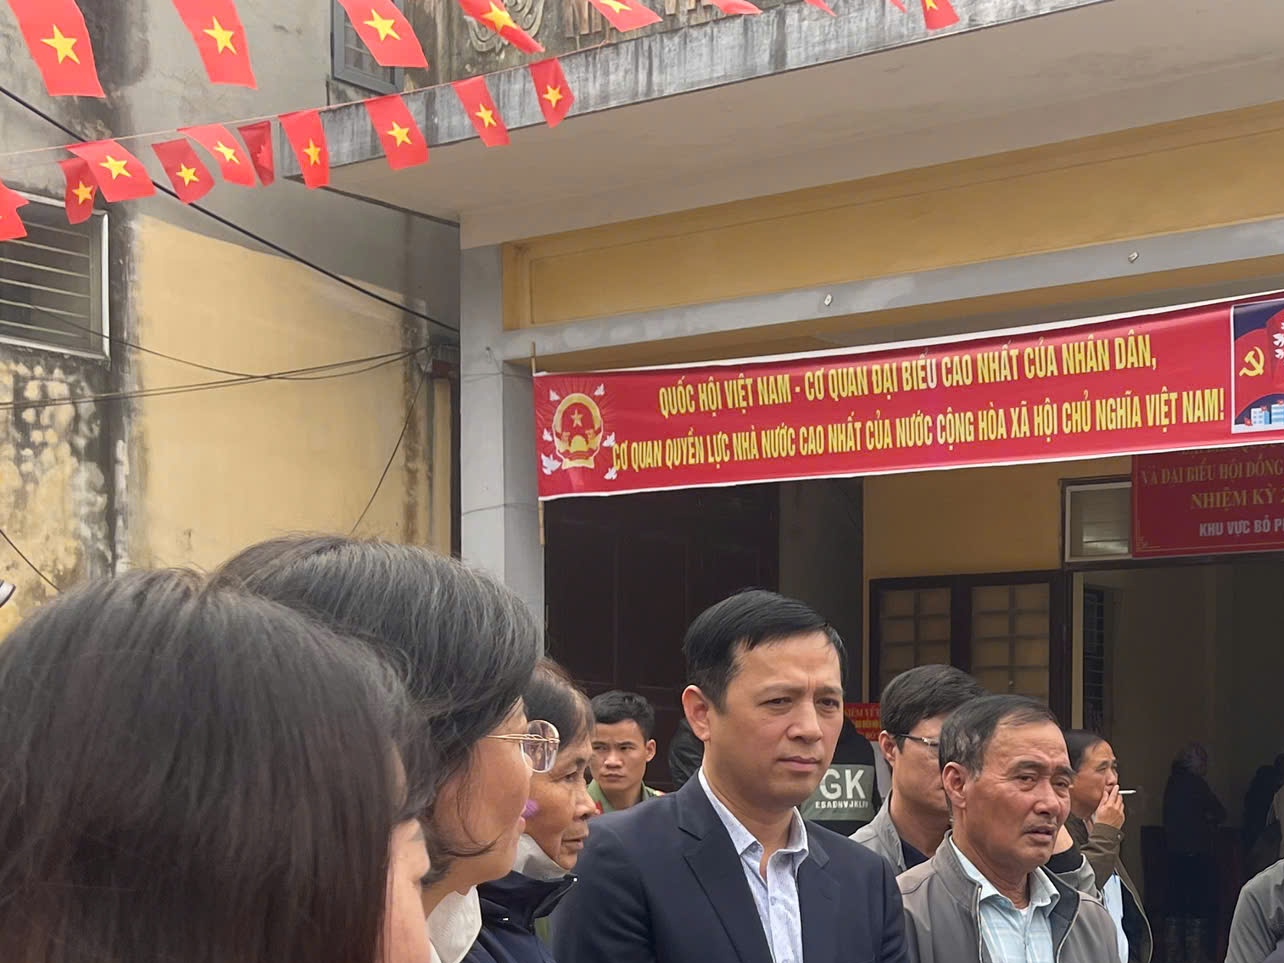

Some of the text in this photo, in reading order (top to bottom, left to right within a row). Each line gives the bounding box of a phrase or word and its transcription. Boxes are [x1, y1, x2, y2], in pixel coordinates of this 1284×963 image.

[659, 376, 695, 418] QUỐC
[698, 376, 722, 416] HỘI
[724, 373, 753, 414] VIỆT
[757, 374, 792, 405] NAM
[804, 368, 825, 400] CƠ
[828, 366, 868, 401] QUAN
[871, 362, 898, 400] ĐẠI
[902, 347, 937, 391] BIỂU
[941, 354, 972, 388] CAO
[977, 339, 1019, 384] NHẤT
[1024, 336, 1058, 379] CỦA
[1061, 334, 1109, 375] NHÂN
[1114, 329, 1156, 370] DÂN,
[612, 386, 1225, 473] CƠ QUAN QUYỀN LỰC NHÀ NƯỚC CAO NHẤT CỦA NƯỚC CỘNG HÒA XÃ HỘI CHỦ NGHĨA VIỆT NAM!
[1219, 460, 1246, 481] HỘI
[1248, 454, 1283, 478] ĐỒNG
[1191, 485, 1248, 512] NHIỆM
[1252, 483, 1276, 505] KỲ
[1199, 521, 1223, 537] KHU
[1227, 519, 1250, 536] VỰC
[1254, 513, 1270, 532] BỎ
[820, 768, 866, 800] GK
